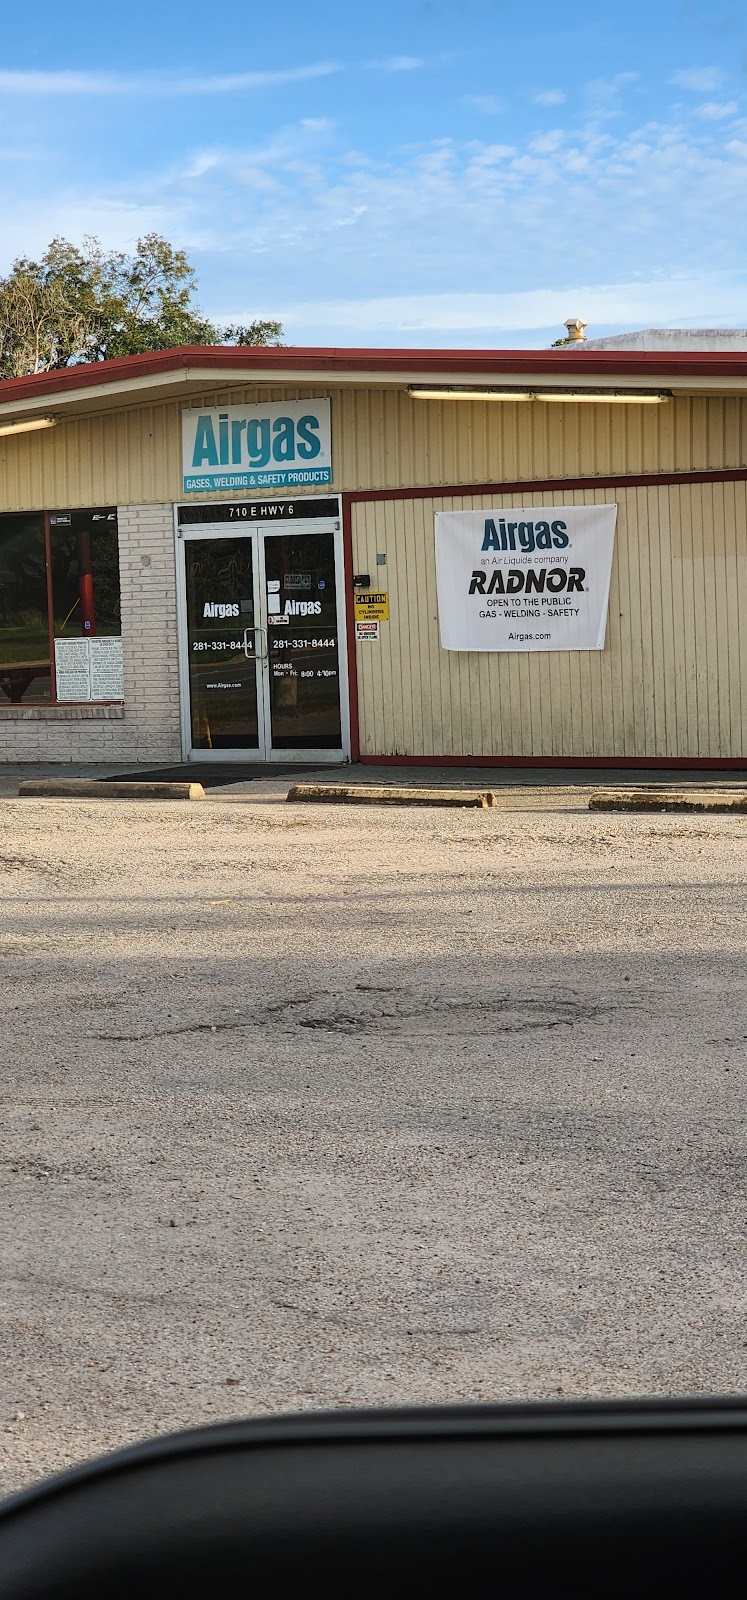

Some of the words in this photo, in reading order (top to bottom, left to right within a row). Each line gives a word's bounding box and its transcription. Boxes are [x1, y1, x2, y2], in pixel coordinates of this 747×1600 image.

[192, 413, 321, 468] Airgas
[186, 478, 212, 489] GASES,
[213, 476, 248, 487] WELDING
[250, 476, 256, 485] &
[257, 473, 286, 484] SAFETY
[288, 471, 329, 483] PRODUCTS
[228, 507, 247, 517] 710
[250, 506, 257, 516] E
[260, 505, 285, 516] HWY
[288, 505, 294, 515] 6
[481, 518, 569, 553] Airgas
[491, 556, 502, 564] Air
[503, 555, 532, 566] Liquide
[533, 555, 569, 565] company
[468, 567, 586, 595] RADNOR
[356, 595, 386, 603] CAUTION
[486, 598, 509, 607] OPEN
[510, 598, 521, 607] TO
[523, 598, 539, 606] THE
[541, 597, 572, 606] PUBLIC
[203, 602, 240, 619] Airgas
[284, 599, 322, 616] Airgas
[479, 610, 497, 618] GAS
[503, 609, 541, 618] WELDING
[547, 608, 580, 617] SAFETY
[508, 632, 551, 642] Airgas.com
[192, 640, 253, 651] 281-331-8444
[273, 639, 335, 649] 281-331-8444
[300, 670, 314, 678] 8:00
[206, 682, 242, 690] www.Airgas.com
